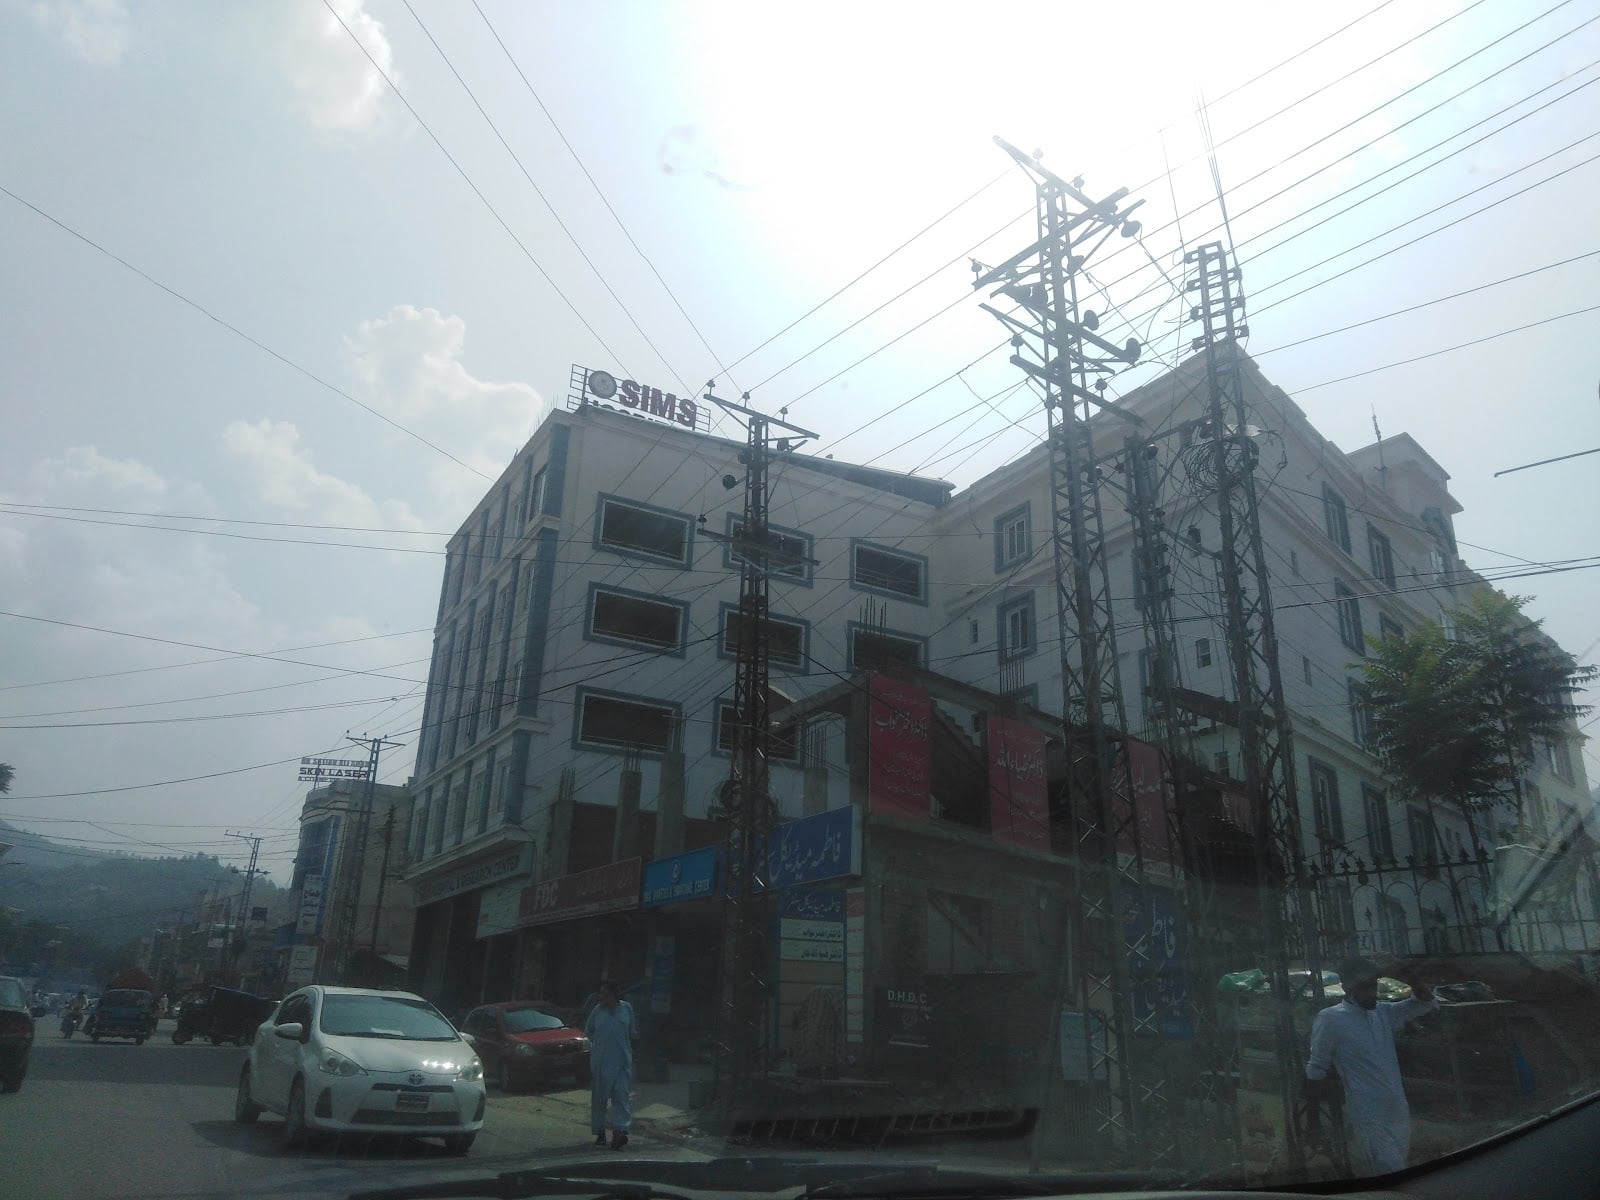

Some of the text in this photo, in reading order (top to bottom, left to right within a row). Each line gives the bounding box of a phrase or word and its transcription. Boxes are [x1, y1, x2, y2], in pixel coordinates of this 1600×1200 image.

[619, 379, 697, 428] SIMS
[299, 767, 368, 778] SKIN LASER
[768, 825, 812, 884] میڈیکل
[810, 823, 842, 868] فاطمہ
